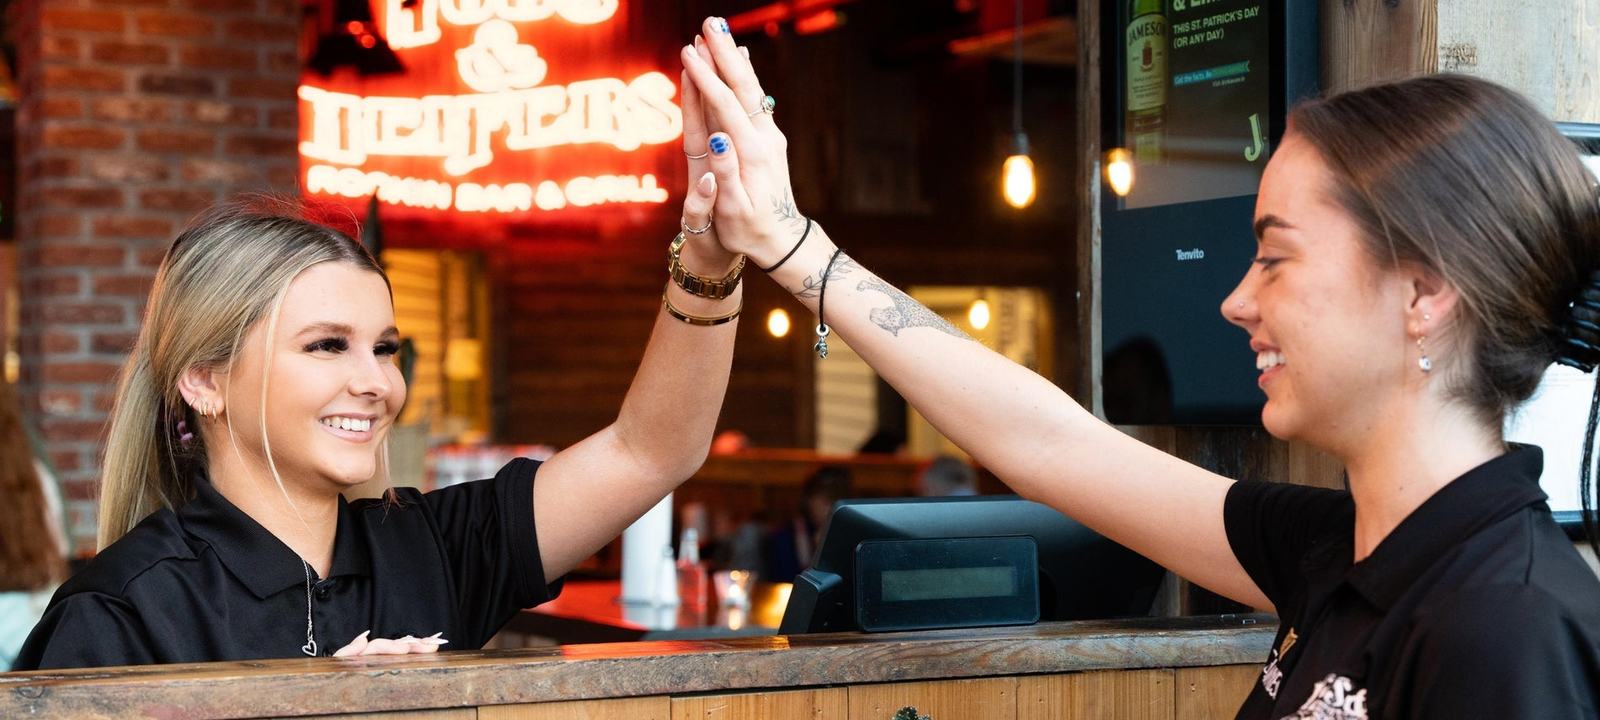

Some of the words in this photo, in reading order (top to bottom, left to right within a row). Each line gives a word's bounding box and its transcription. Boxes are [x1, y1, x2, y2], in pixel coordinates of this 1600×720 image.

[1128, 21, 1166, 46] JAMESO
[1173, 22, 1190, 34] THIS
[1191, 20, 1202, 31] ST.
[1203, 10, 1243, 28] PATRICK'S
[1244, 6, 1260, 18] DAY
[1173, 37, 1188, 49] (OR
[1189, 32, 1205, 45] ANY
[1206, 28, 1225, 42] DAY)
[455, 18, 548, 93] &
[455, 182, 532, 212] BAR
[535, 180, 567, 210] &
[565, 174, 669, 206] GRILL
